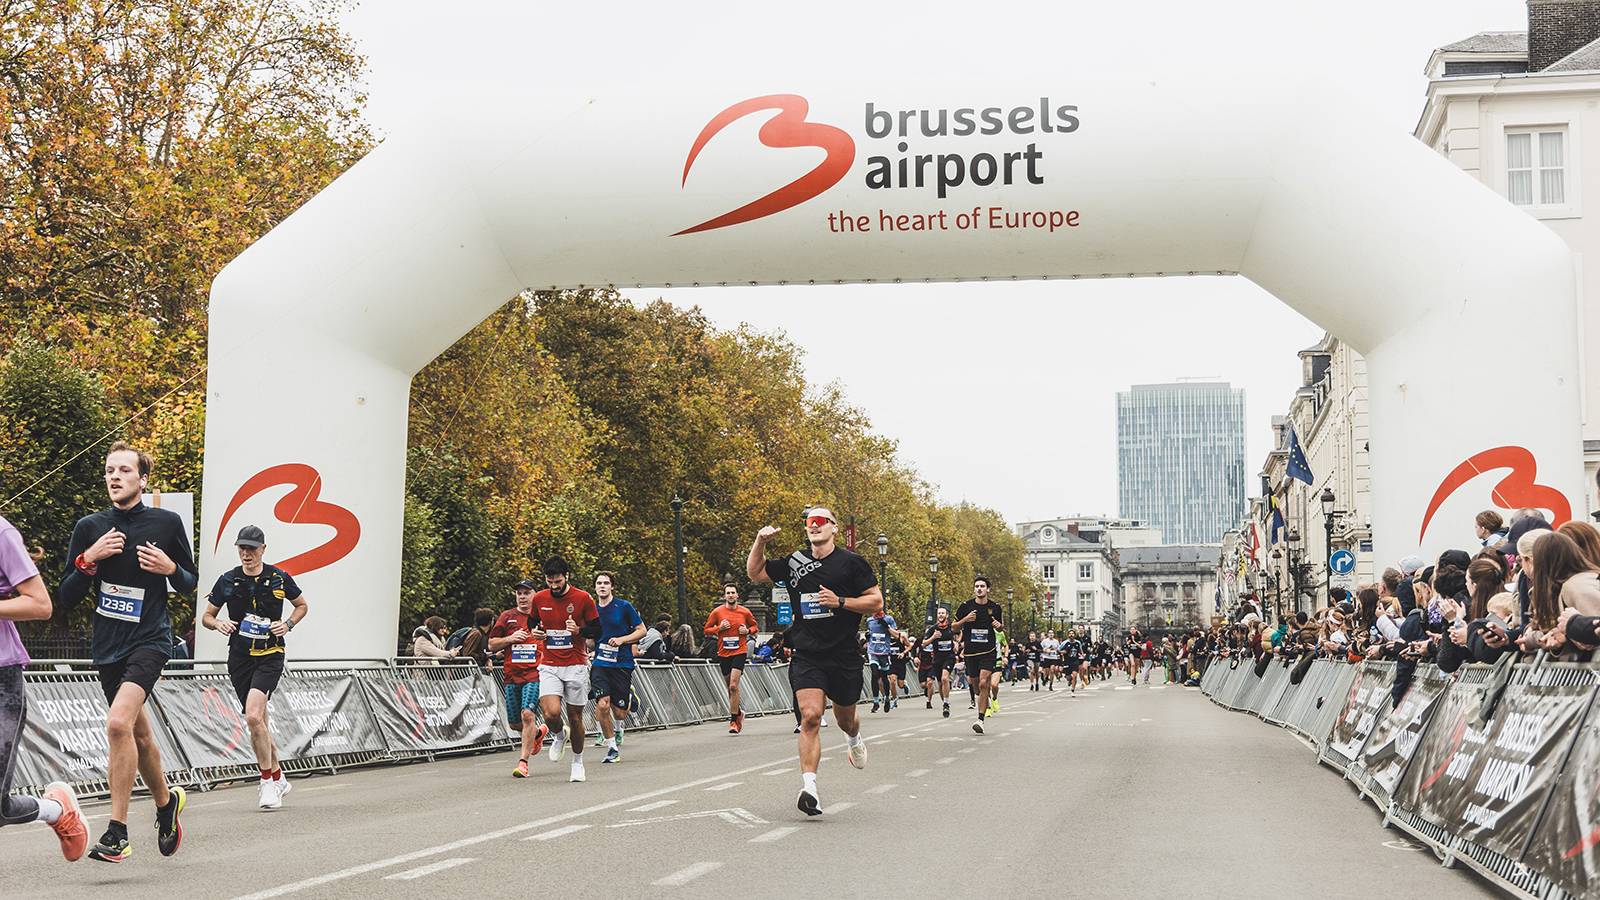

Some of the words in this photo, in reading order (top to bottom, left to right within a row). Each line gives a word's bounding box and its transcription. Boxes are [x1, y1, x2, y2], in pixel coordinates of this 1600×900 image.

[865, 97, 1080, 139] brussels
[865, 142, 1044, 199] airport
[828, 210, 870, 233] the
[880, 208, 948, 232] heart
[956, 206, 981, 231] of
[989, 206, 1080, 233] Europe
[101, 597, 135, 613] 12336
[36, 698, 108, 723] BRUSSELS
[51, 727, 110, 752] MARAT
